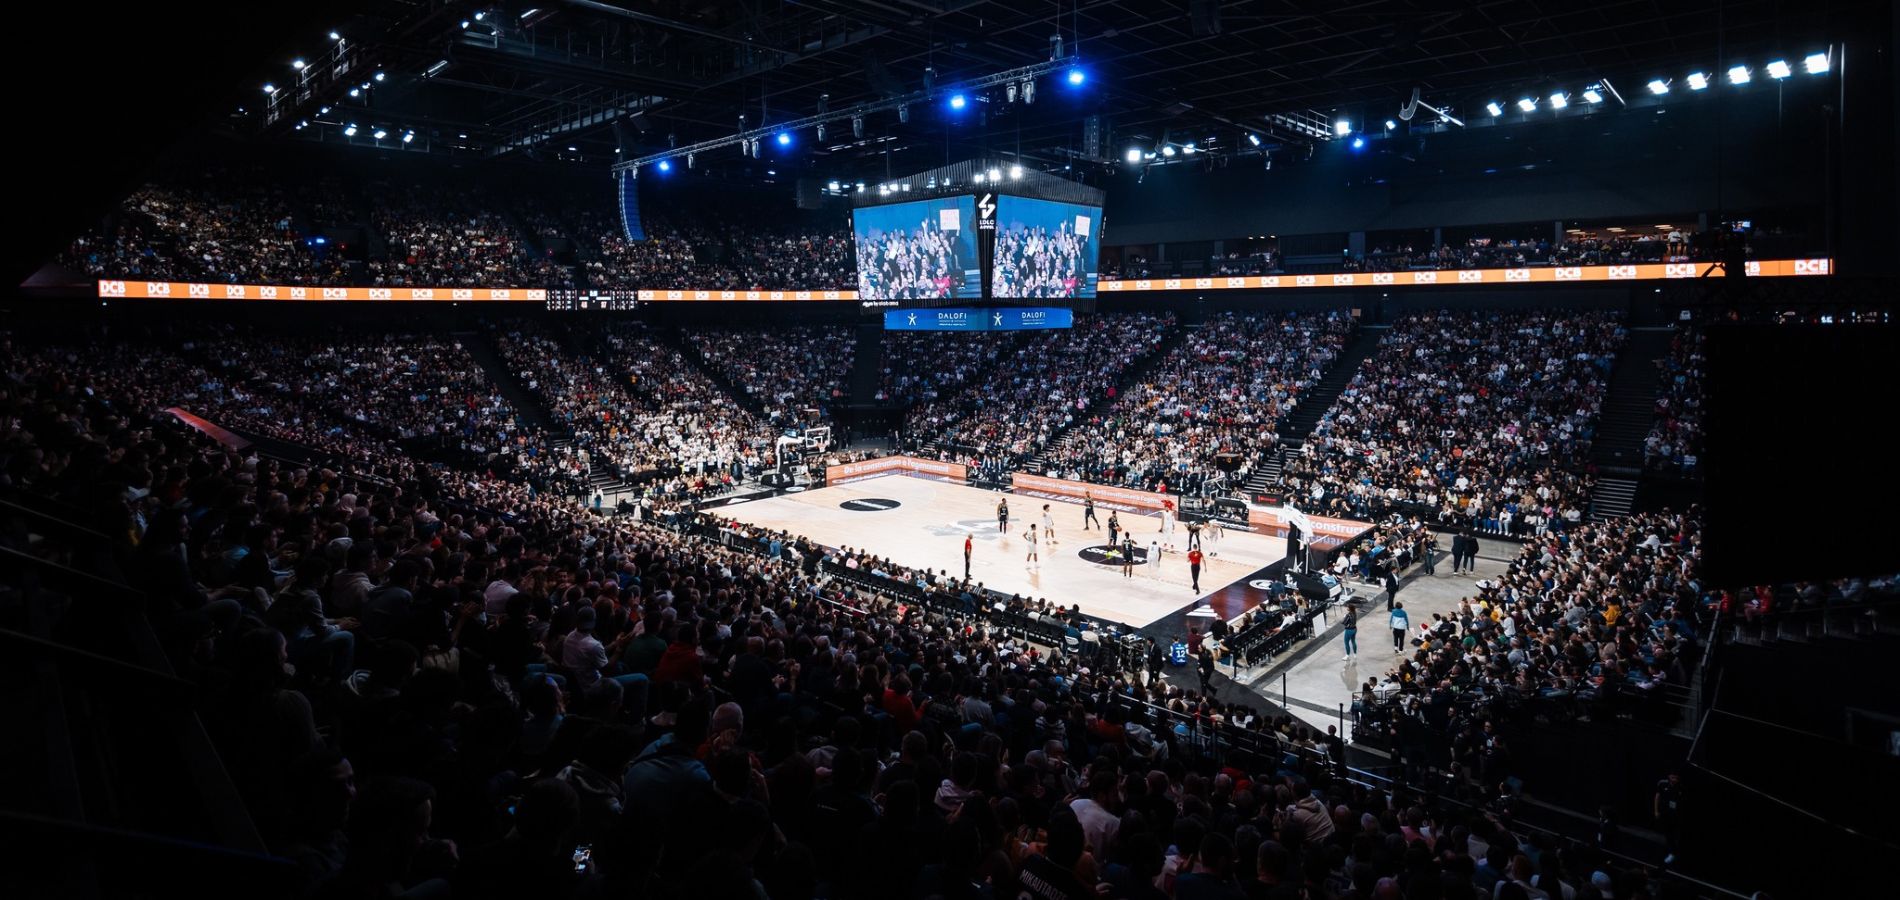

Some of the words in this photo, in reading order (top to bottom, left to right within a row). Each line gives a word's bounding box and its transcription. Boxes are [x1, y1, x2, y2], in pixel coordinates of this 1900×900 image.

[1459, 270, 1482, 281] DCB
[1505, 269, 1530, 279] DCB
[1555, 267, 1581, 278] DCB
[1609, 266, 1636, 277] DCB
[1666, 264, 1696, 275] DCB
[100, 281, 125, 294] DCB
[148, 282, 170, 295] DCB
[190, 284, 209, 295] DCB
[938, 312, 967, 320] DALOFI
[1176, 650, 1186, 658] 12
